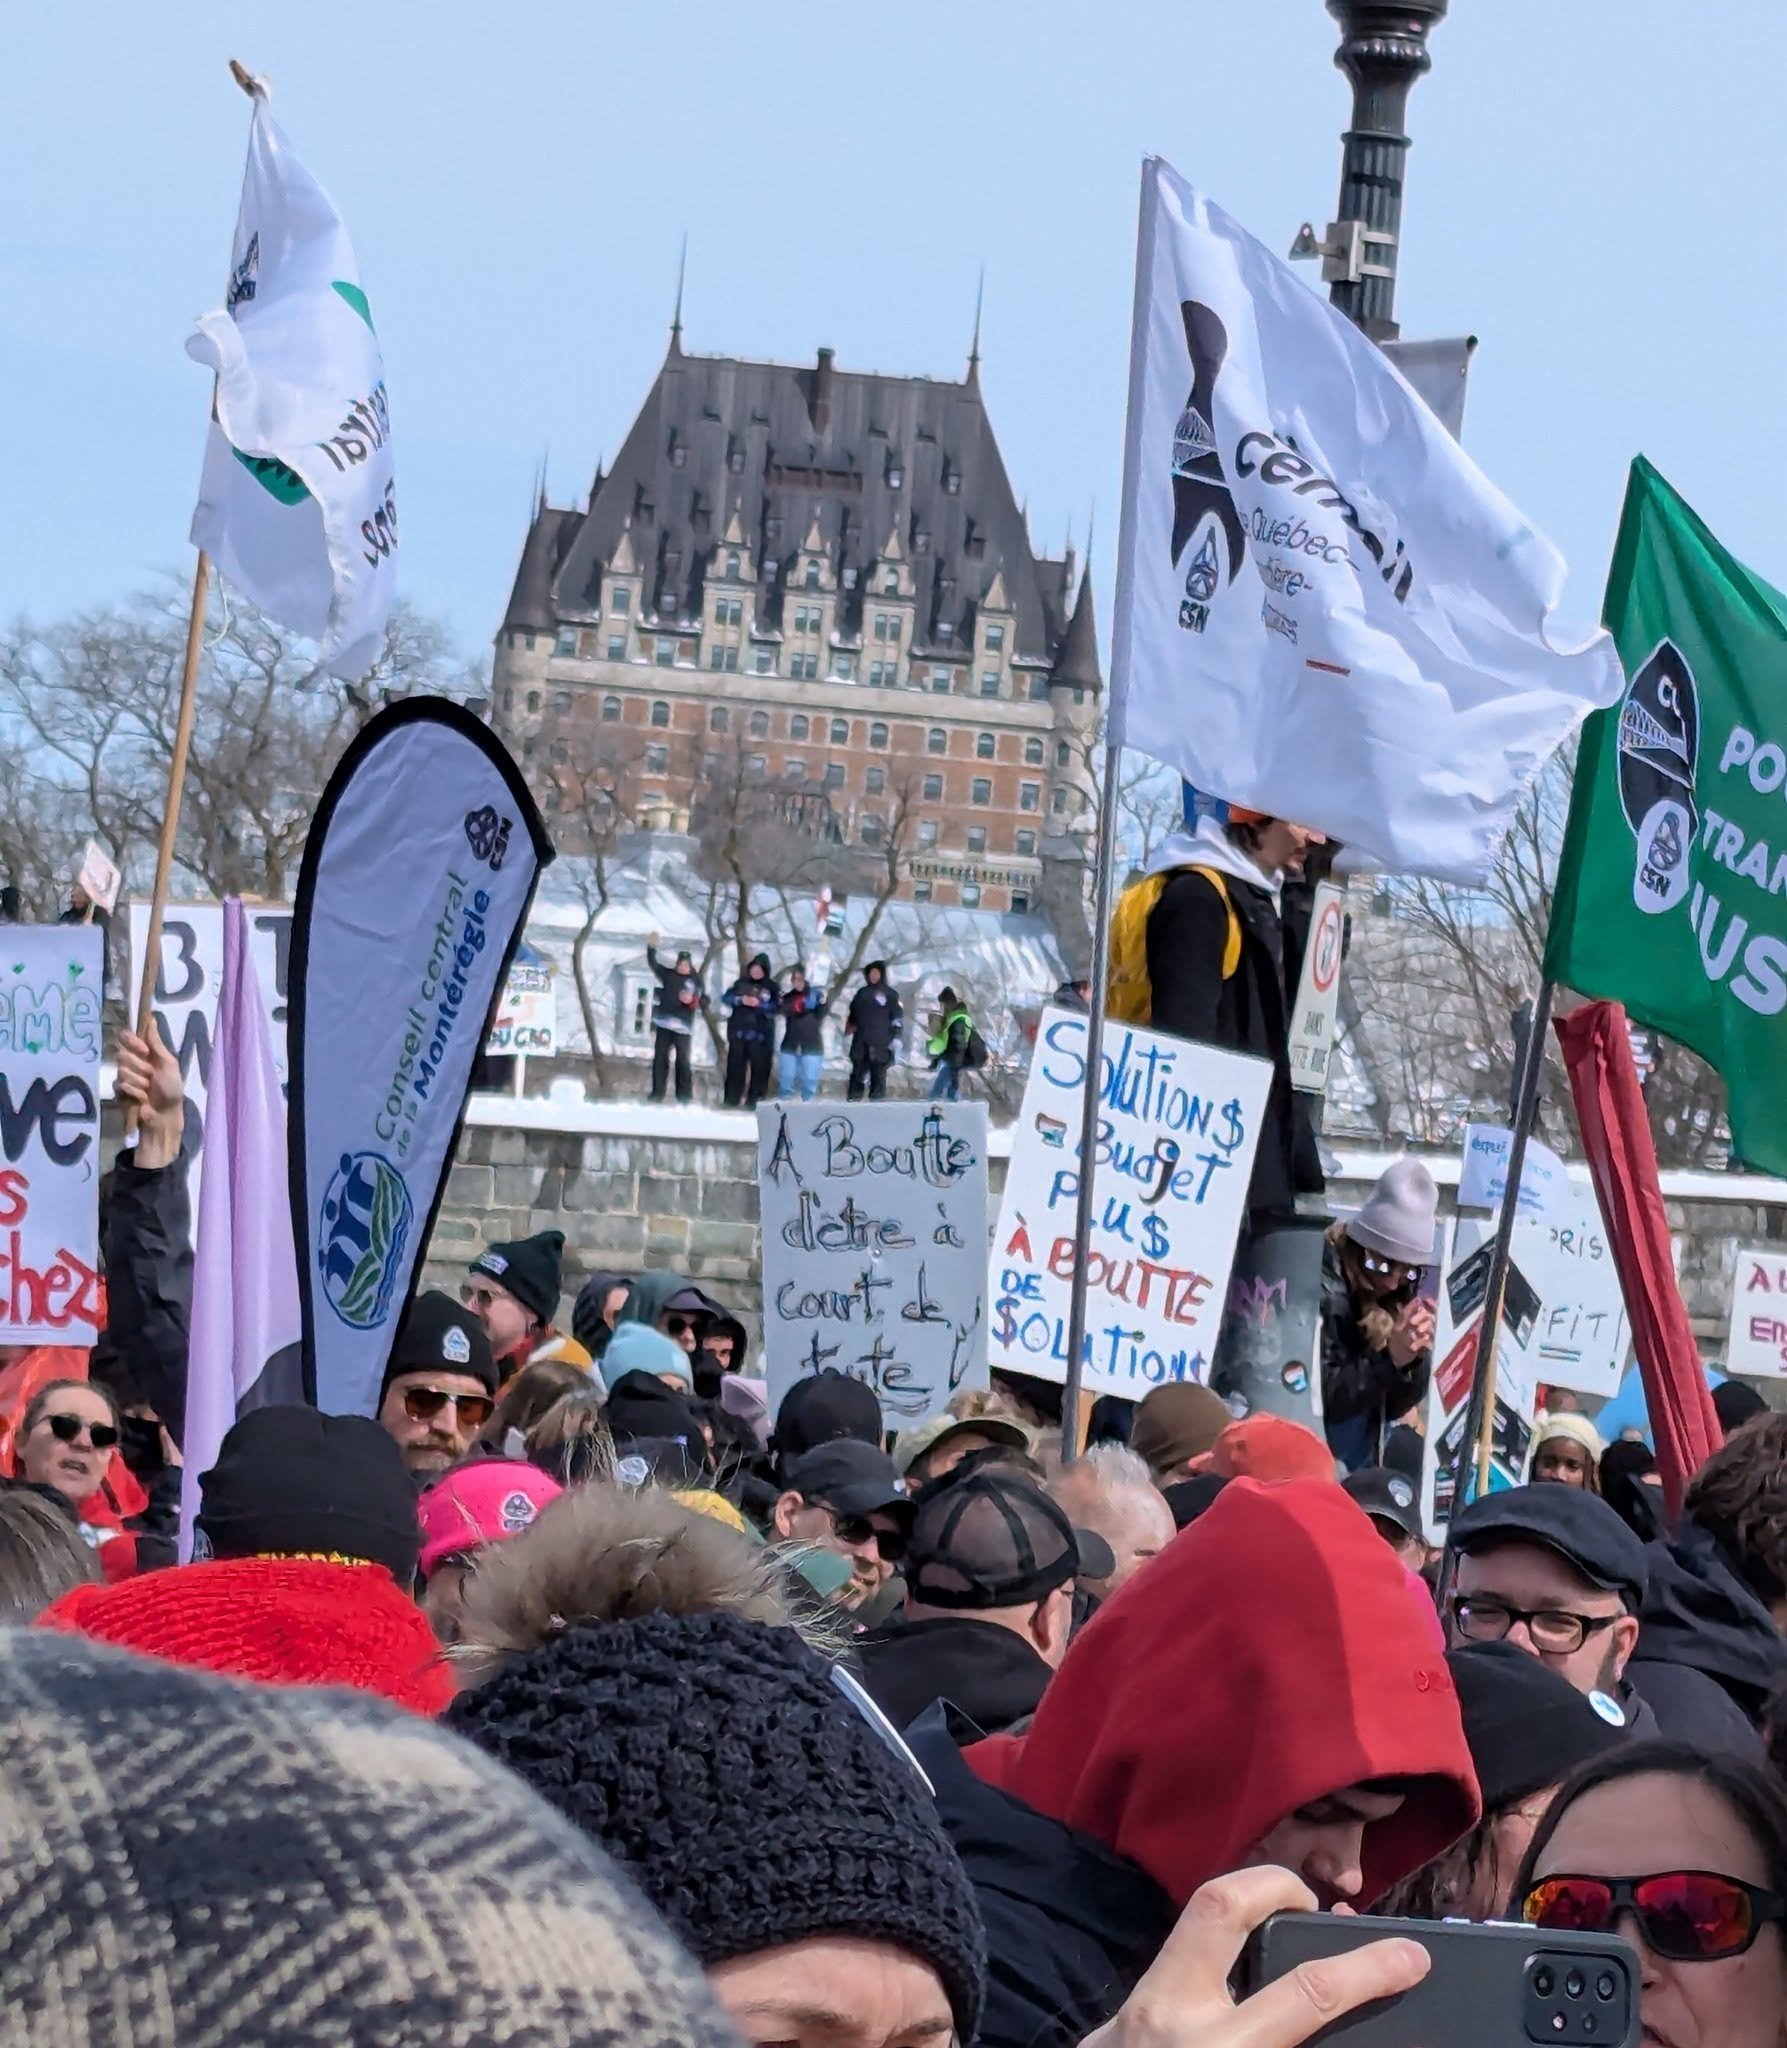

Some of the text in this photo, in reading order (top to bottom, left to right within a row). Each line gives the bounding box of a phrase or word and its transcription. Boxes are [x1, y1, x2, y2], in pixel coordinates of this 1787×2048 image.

[1720, 727, 1787, 800] PO
[375, 871, 469, 1142] Conseil central
[413, 888, 490, 1100] Montérégie
[812, 1105, 977, 1189] Boutte
[934, 1201, 966, 1249] à
[1005, 1211, 1033, 1263] À
[776, 1265, 894, 1326] court
[1000, 1268, 1047, 1302] DE
